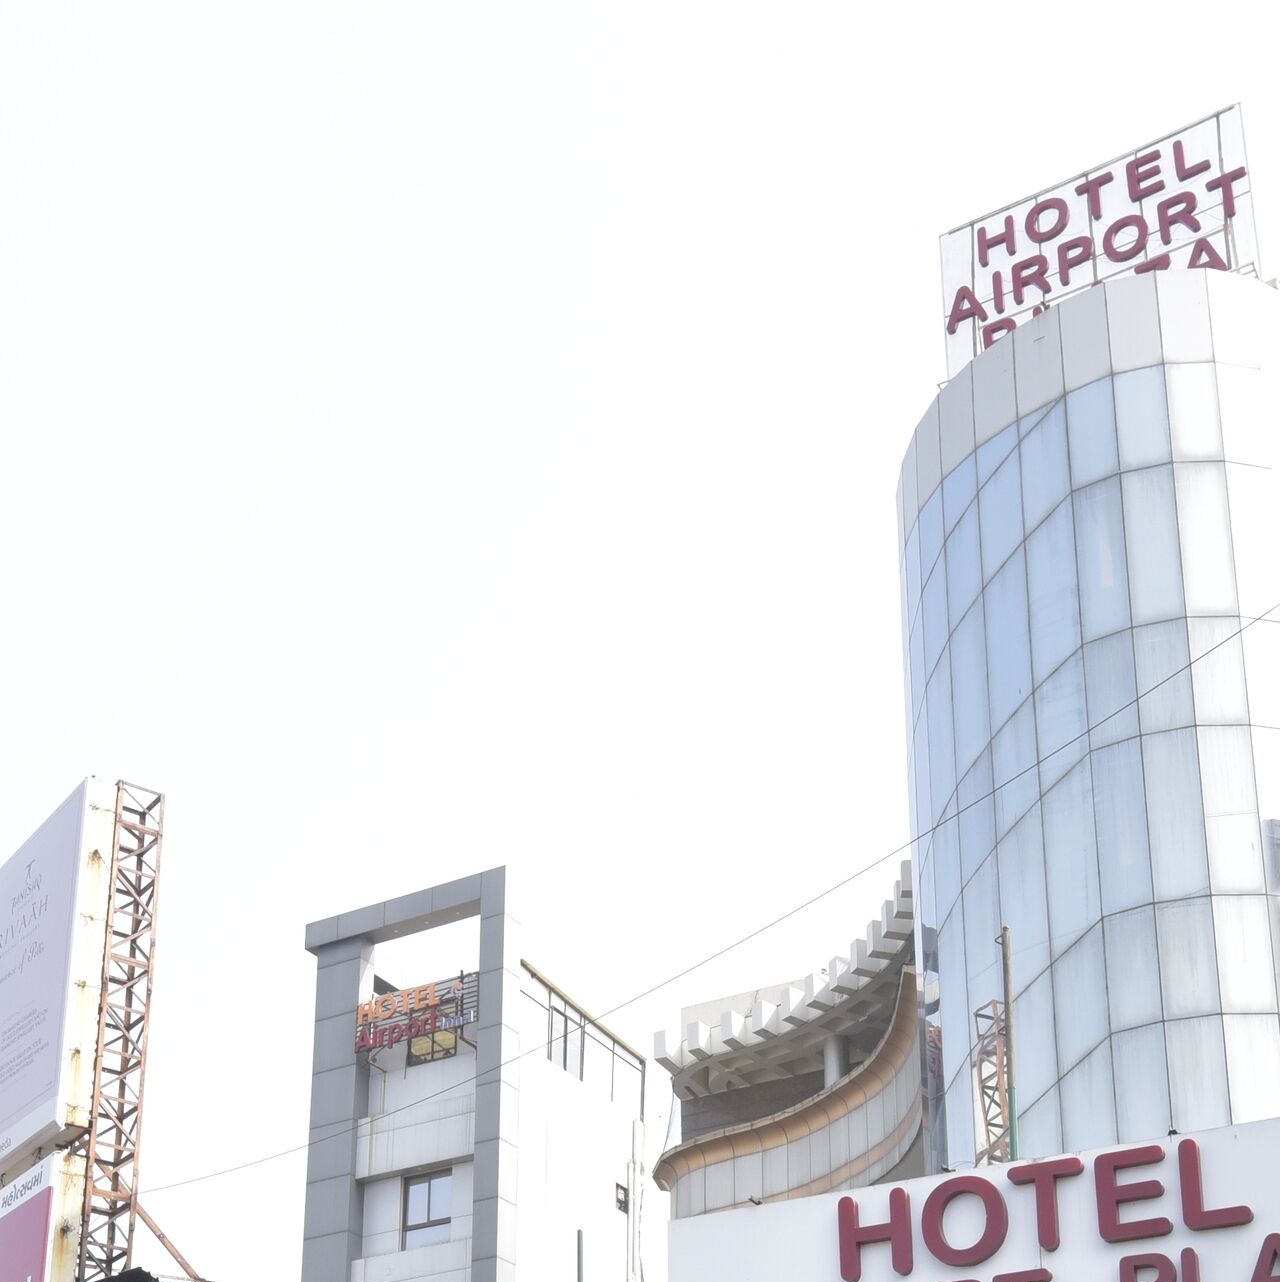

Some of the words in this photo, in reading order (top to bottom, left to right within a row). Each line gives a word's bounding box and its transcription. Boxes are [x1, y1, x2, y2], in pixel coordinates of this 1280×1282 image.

[977, 140, 1211, 268] HOTEL
[946, 166, 1247, 335] AIRPORT
[354, 1008, 438, 1054] Airport
[358, 982, 440, 1025] HOTEL
